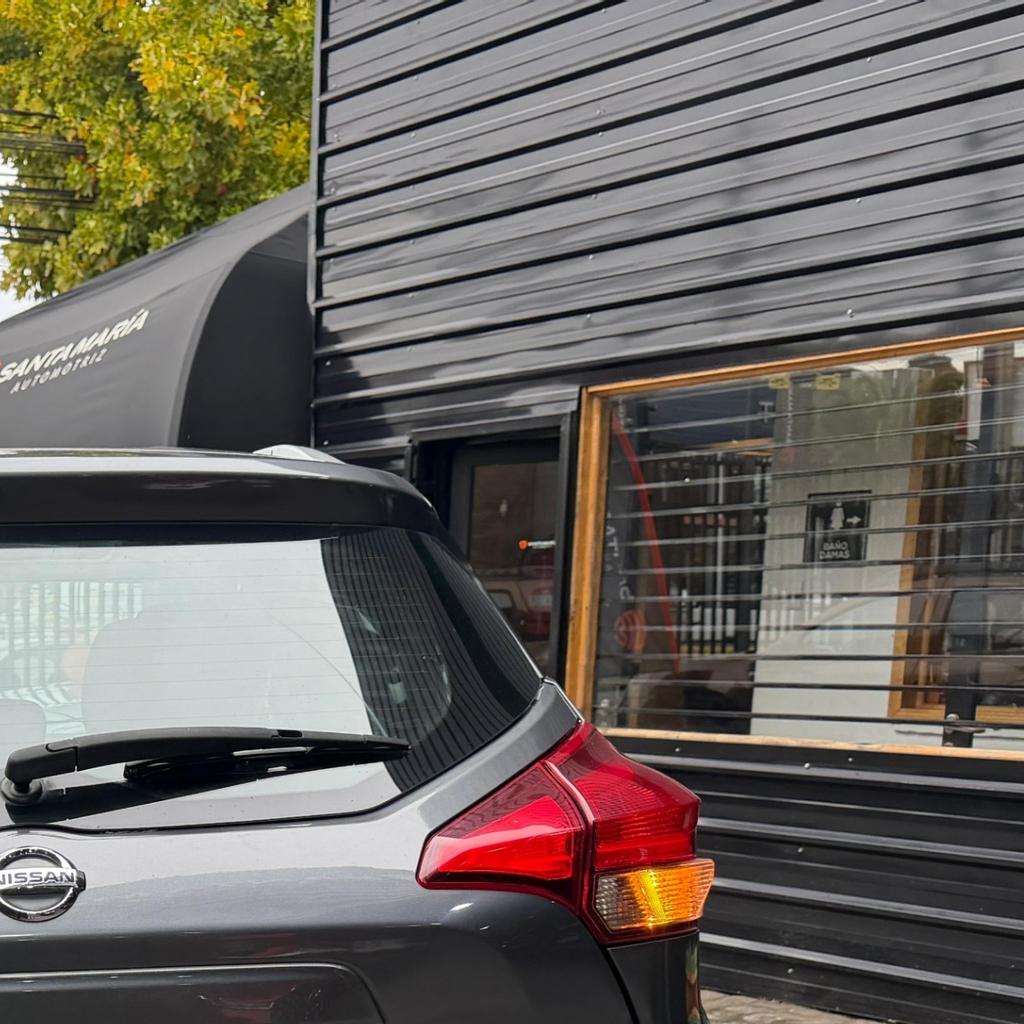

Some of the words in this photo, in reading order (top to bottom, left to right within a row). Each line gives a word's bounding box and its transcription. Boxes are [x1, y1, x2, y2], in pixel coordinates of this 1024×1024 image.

[10, 348, 108, 394] AUTOMOTRIZ
[823, 540, 848, 551] BAÑO
[819, 550, 850, 560] DAMAS
